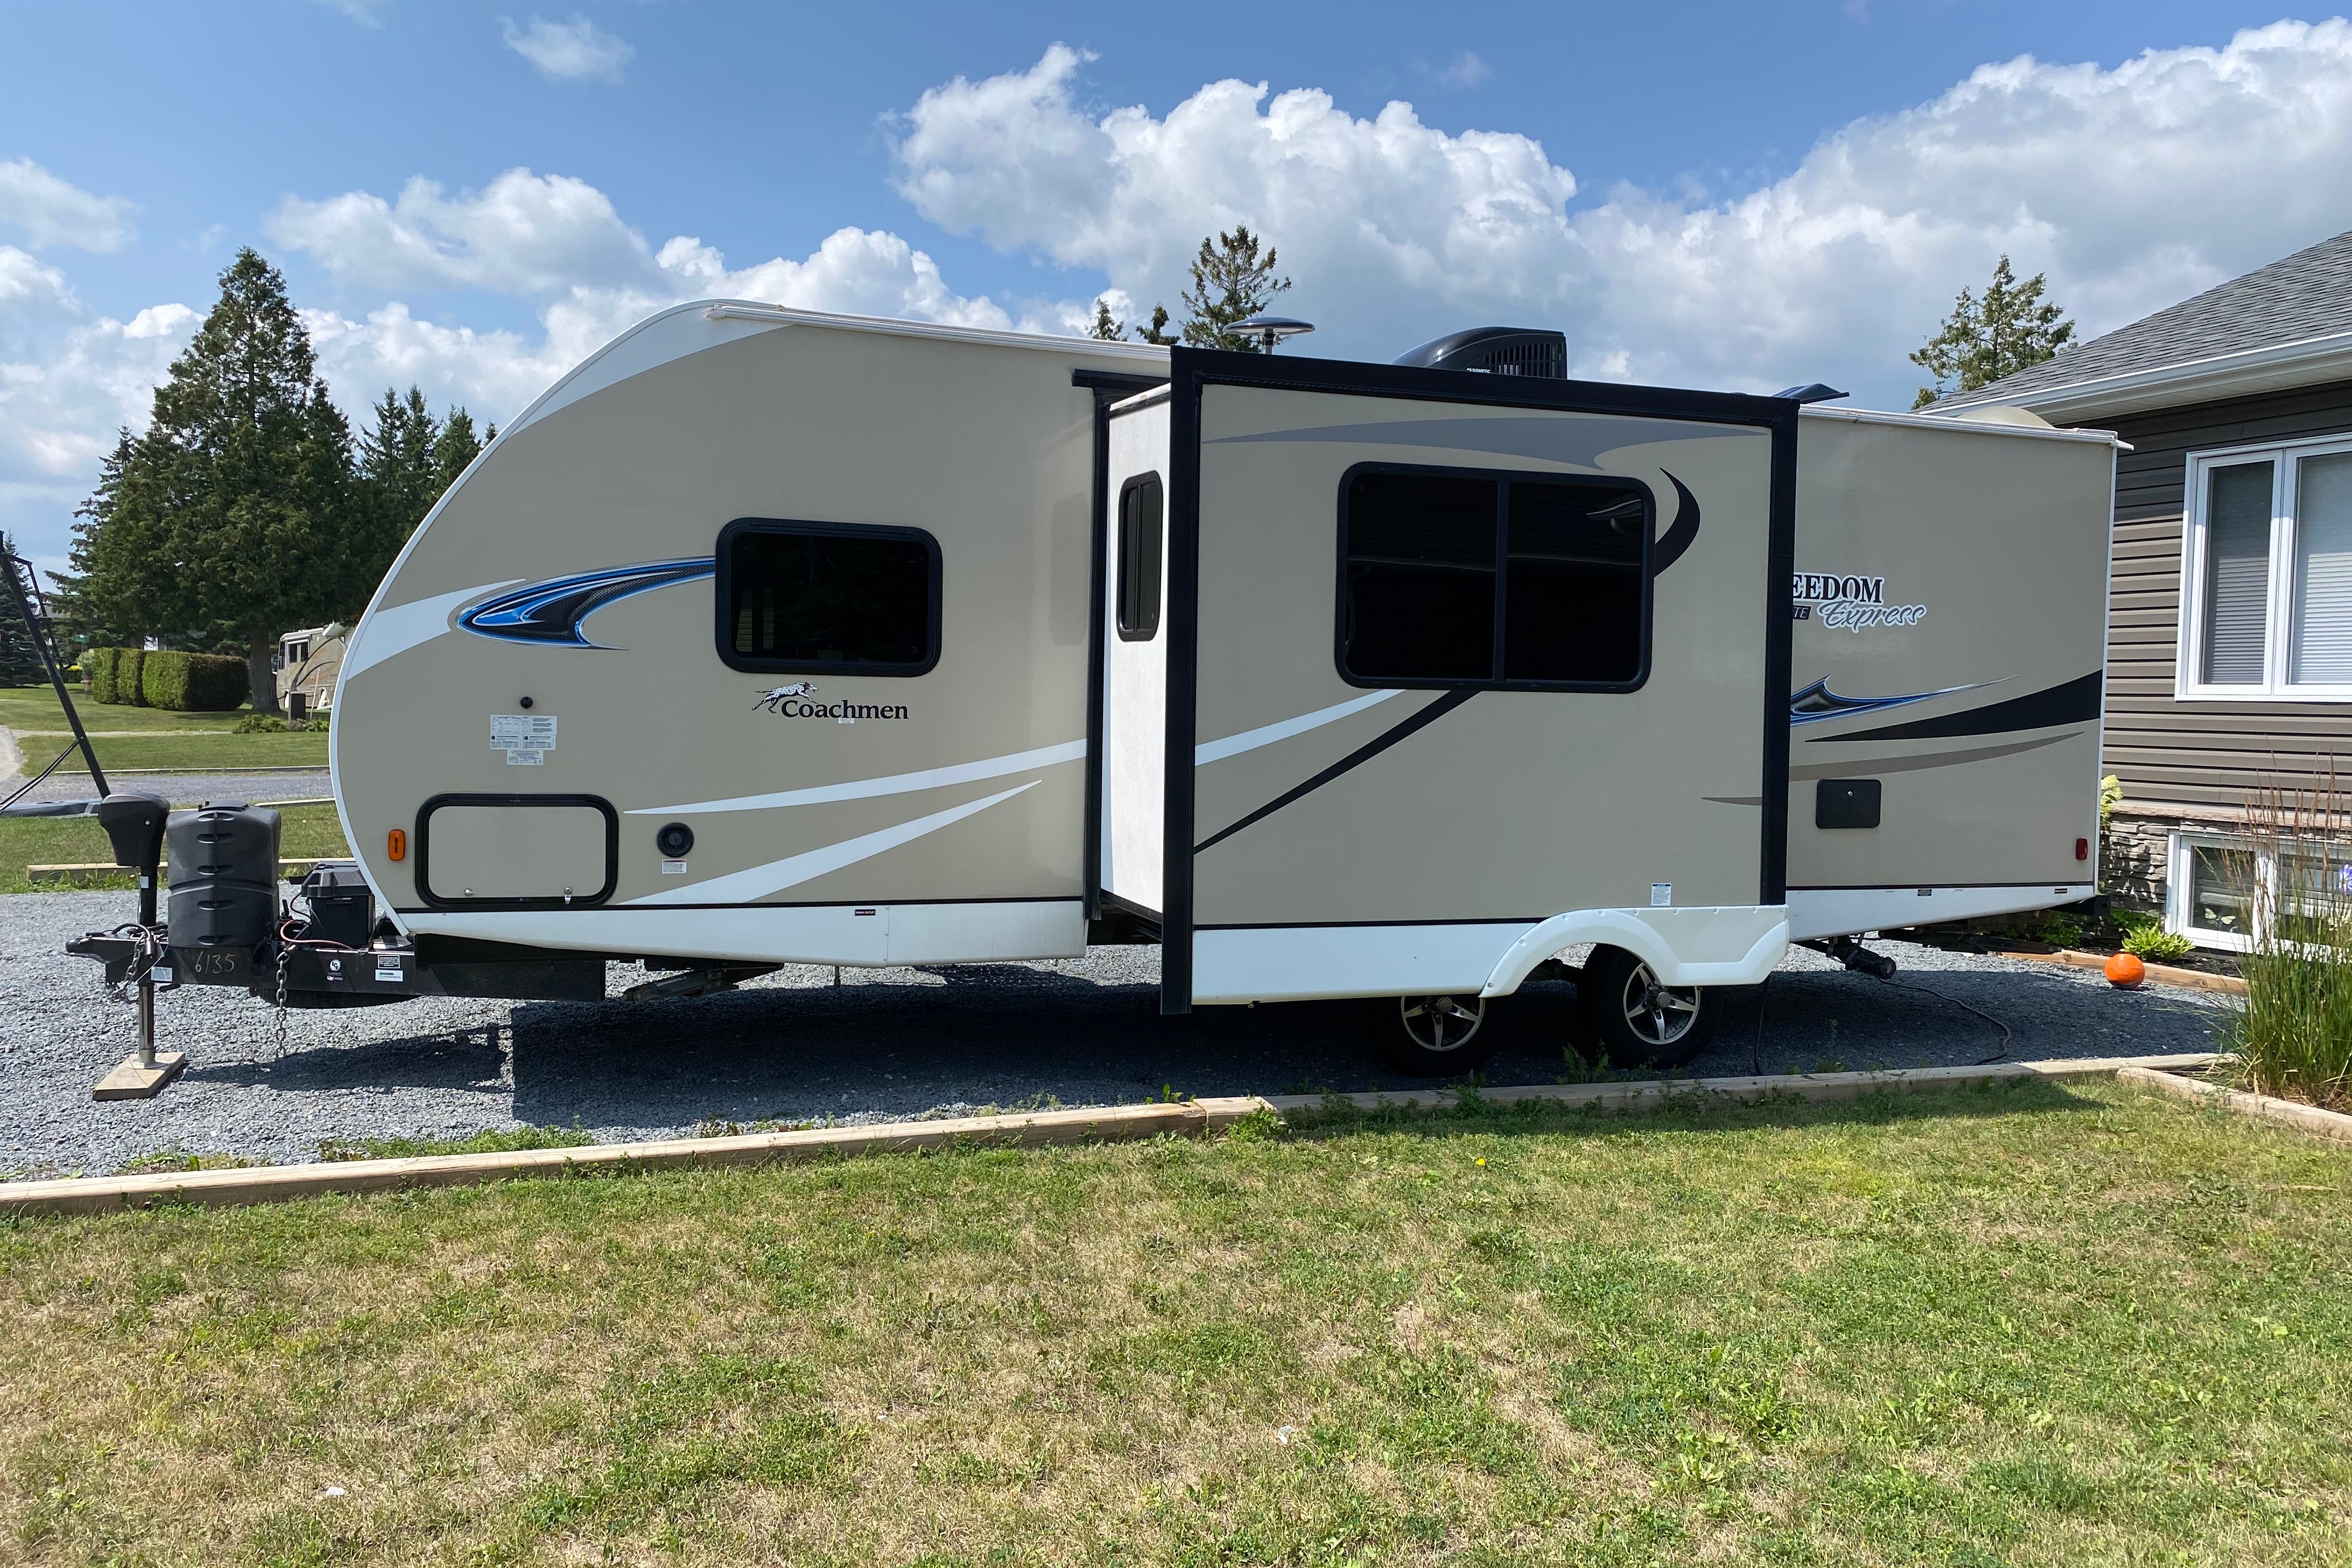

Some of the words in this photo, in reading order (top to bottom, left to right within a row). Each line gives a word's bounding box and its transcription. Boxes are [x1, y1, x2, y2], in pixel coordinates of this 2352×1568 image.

[1793, 574, 1883, 603] EEDOM
[1818, 600, 1926, 632] Express
[781, 699, 909, 719] Coachmen
[195, 950, 236, 974] 6135
